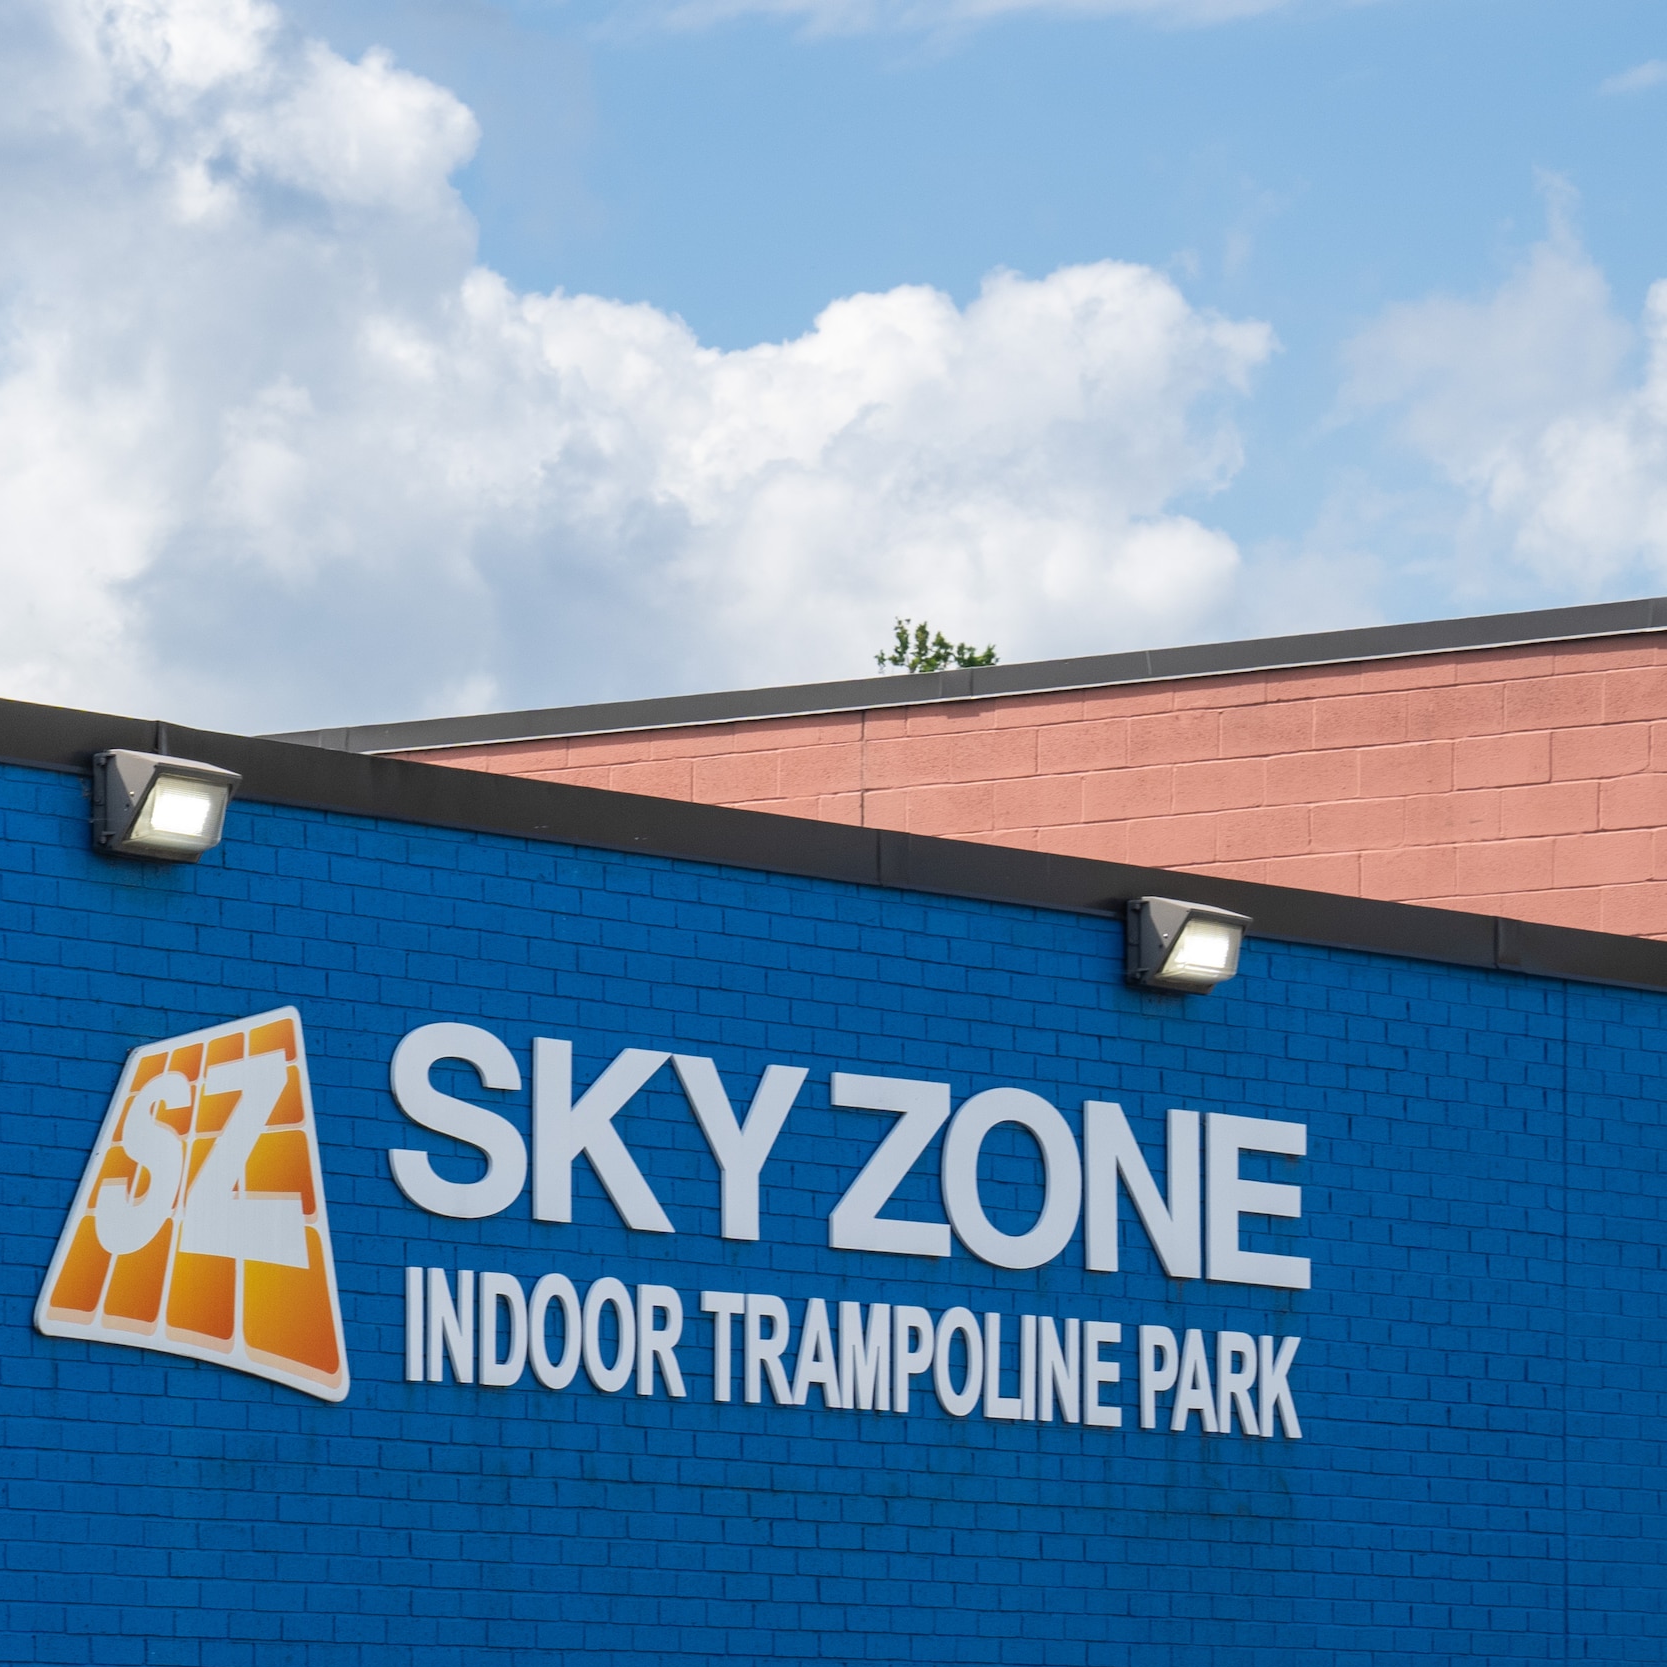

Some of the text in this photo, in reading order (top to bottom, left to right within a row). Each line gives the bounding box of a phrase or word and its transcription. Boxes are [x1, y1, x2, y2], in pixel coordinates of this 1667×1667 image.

[389, 1021, 1313, 1291] SKY ZONE
[405, 1265, 1302, 1439] INDOOR TRAMPOLINE PARK
